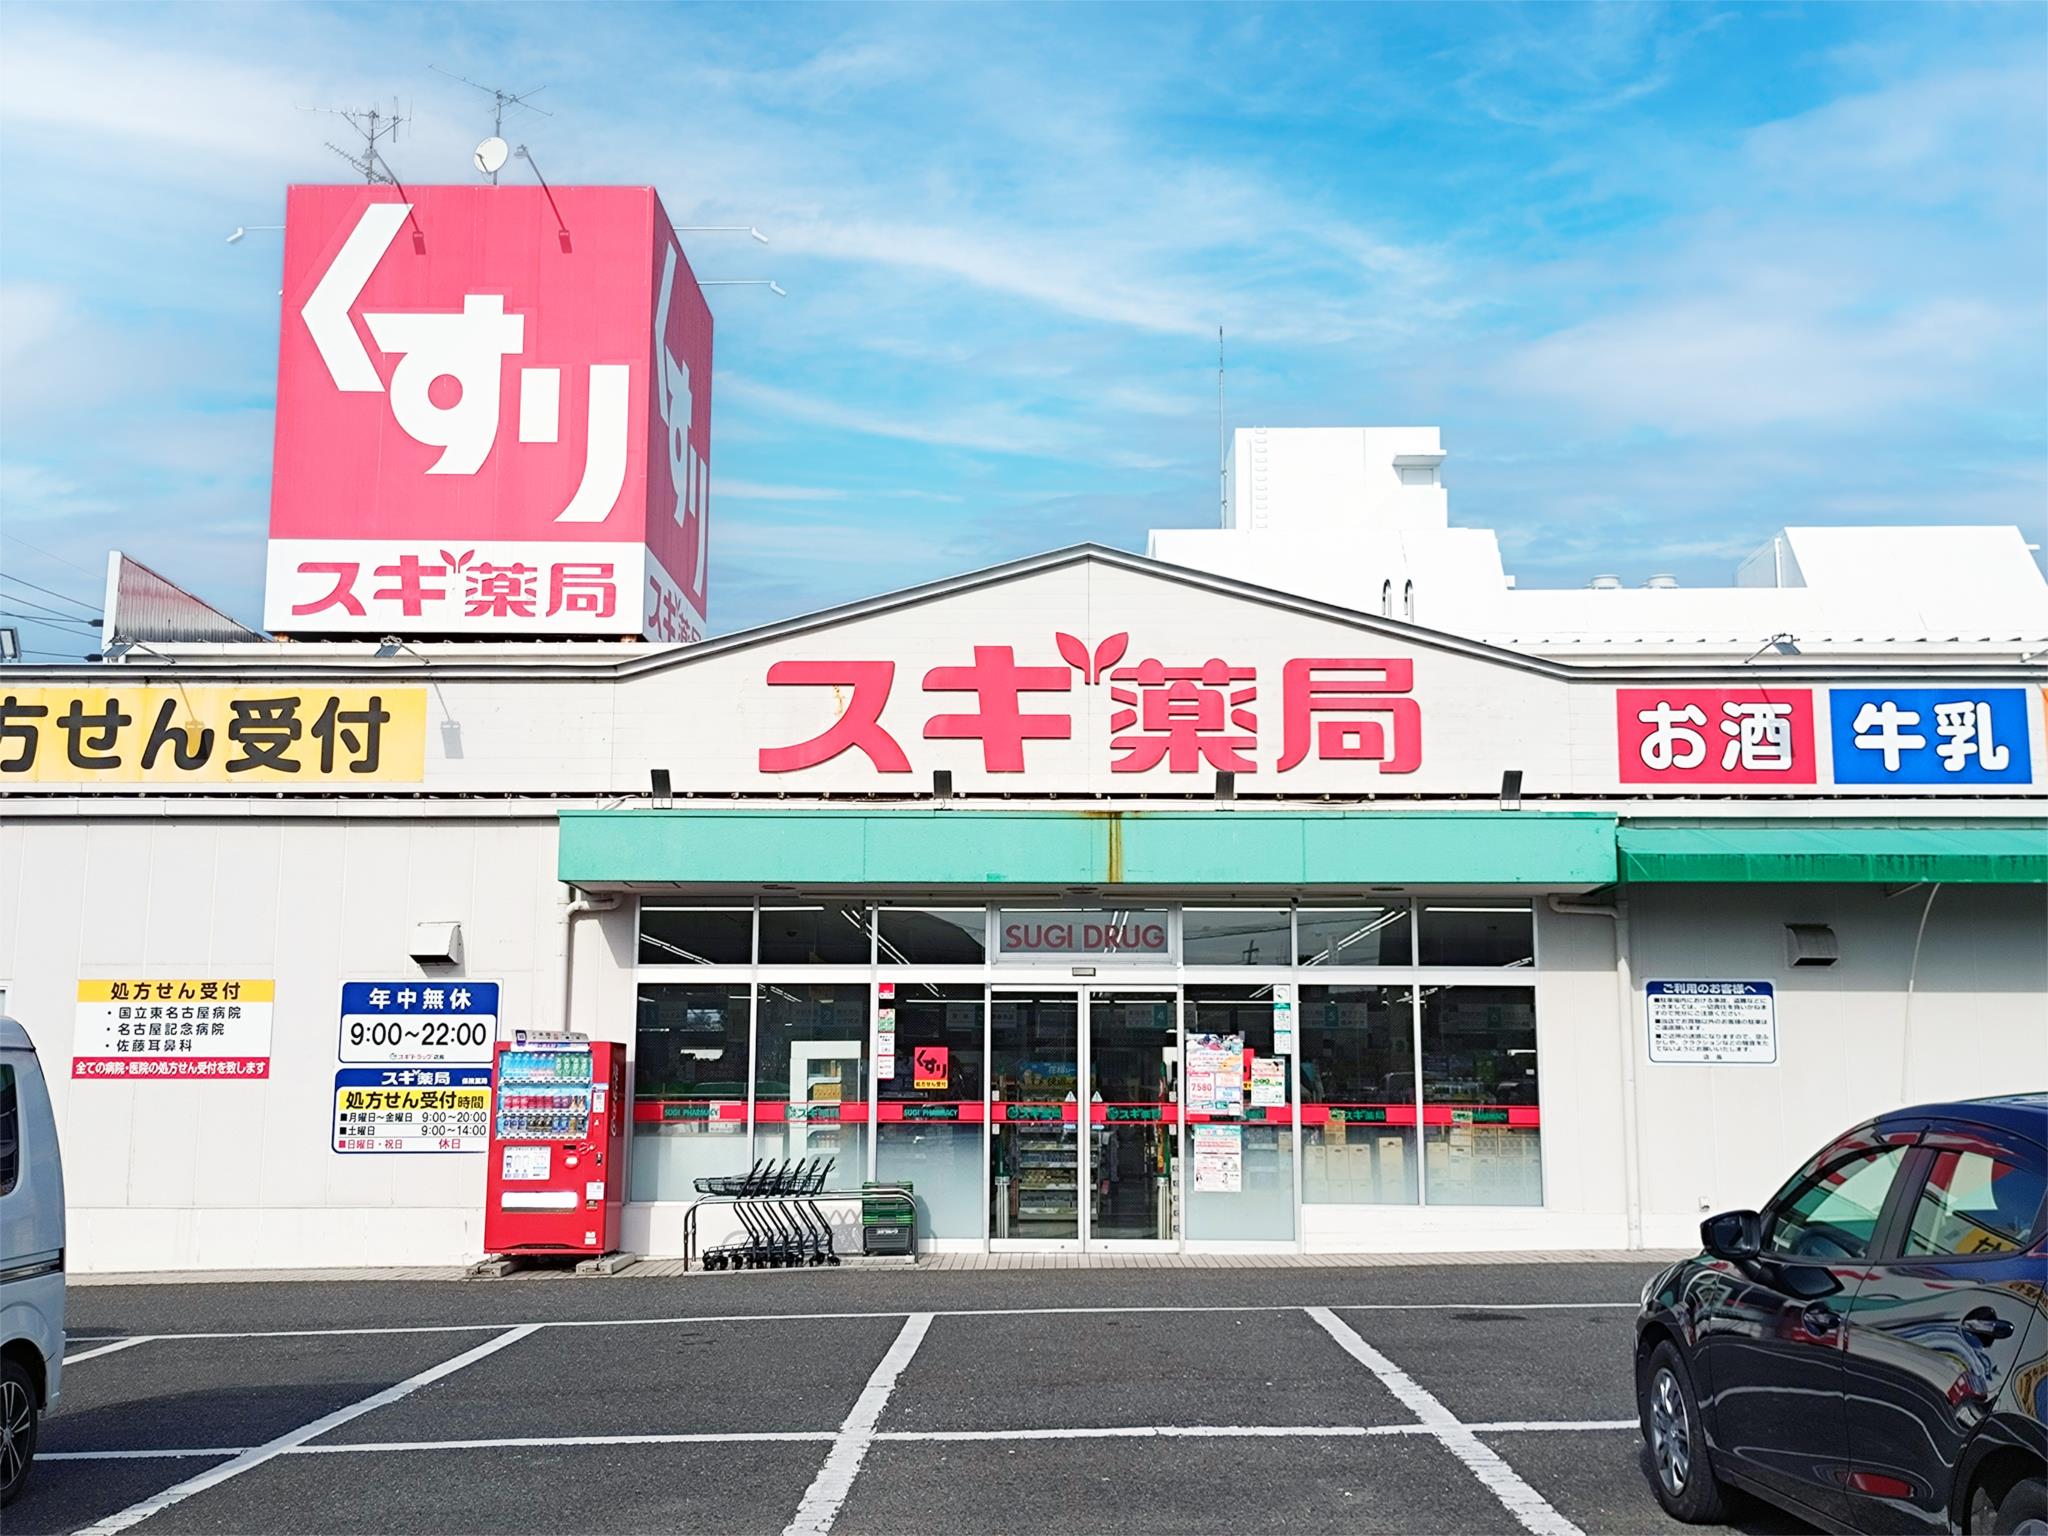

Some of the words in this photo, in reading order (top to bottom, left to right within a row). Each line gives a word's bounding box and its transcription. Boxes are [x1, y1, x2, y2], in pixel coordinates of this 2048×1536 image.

[301, 203, 630, 523] くすり
[655, 239, 707, 598] くすり
[291, 548, 617, 618] スギ薬局
[759, 631, 1422, 774] スギ薬局
[1637, 700, 1794, 772] お酒
[1852, 700, 2010, 772] 牛乳
[1006, 924, 1073, 949] SUGI
[1083, 924, 1166, 949] DRUG
[111, 981, 241, 1000] 処方せん受付
[368, 987, 472, 1010] 年中無休
[119, 1006, 242, 1020] 国立東名古屋病院
[118, 1022, 225, 1036] 名古屋記念病院
[116, 1038, 193, 1052] 佐藤耳鼻科
[381, 1069, 450, 1086] スギ薬局
[916, 1049, 947, 1079] くすり
